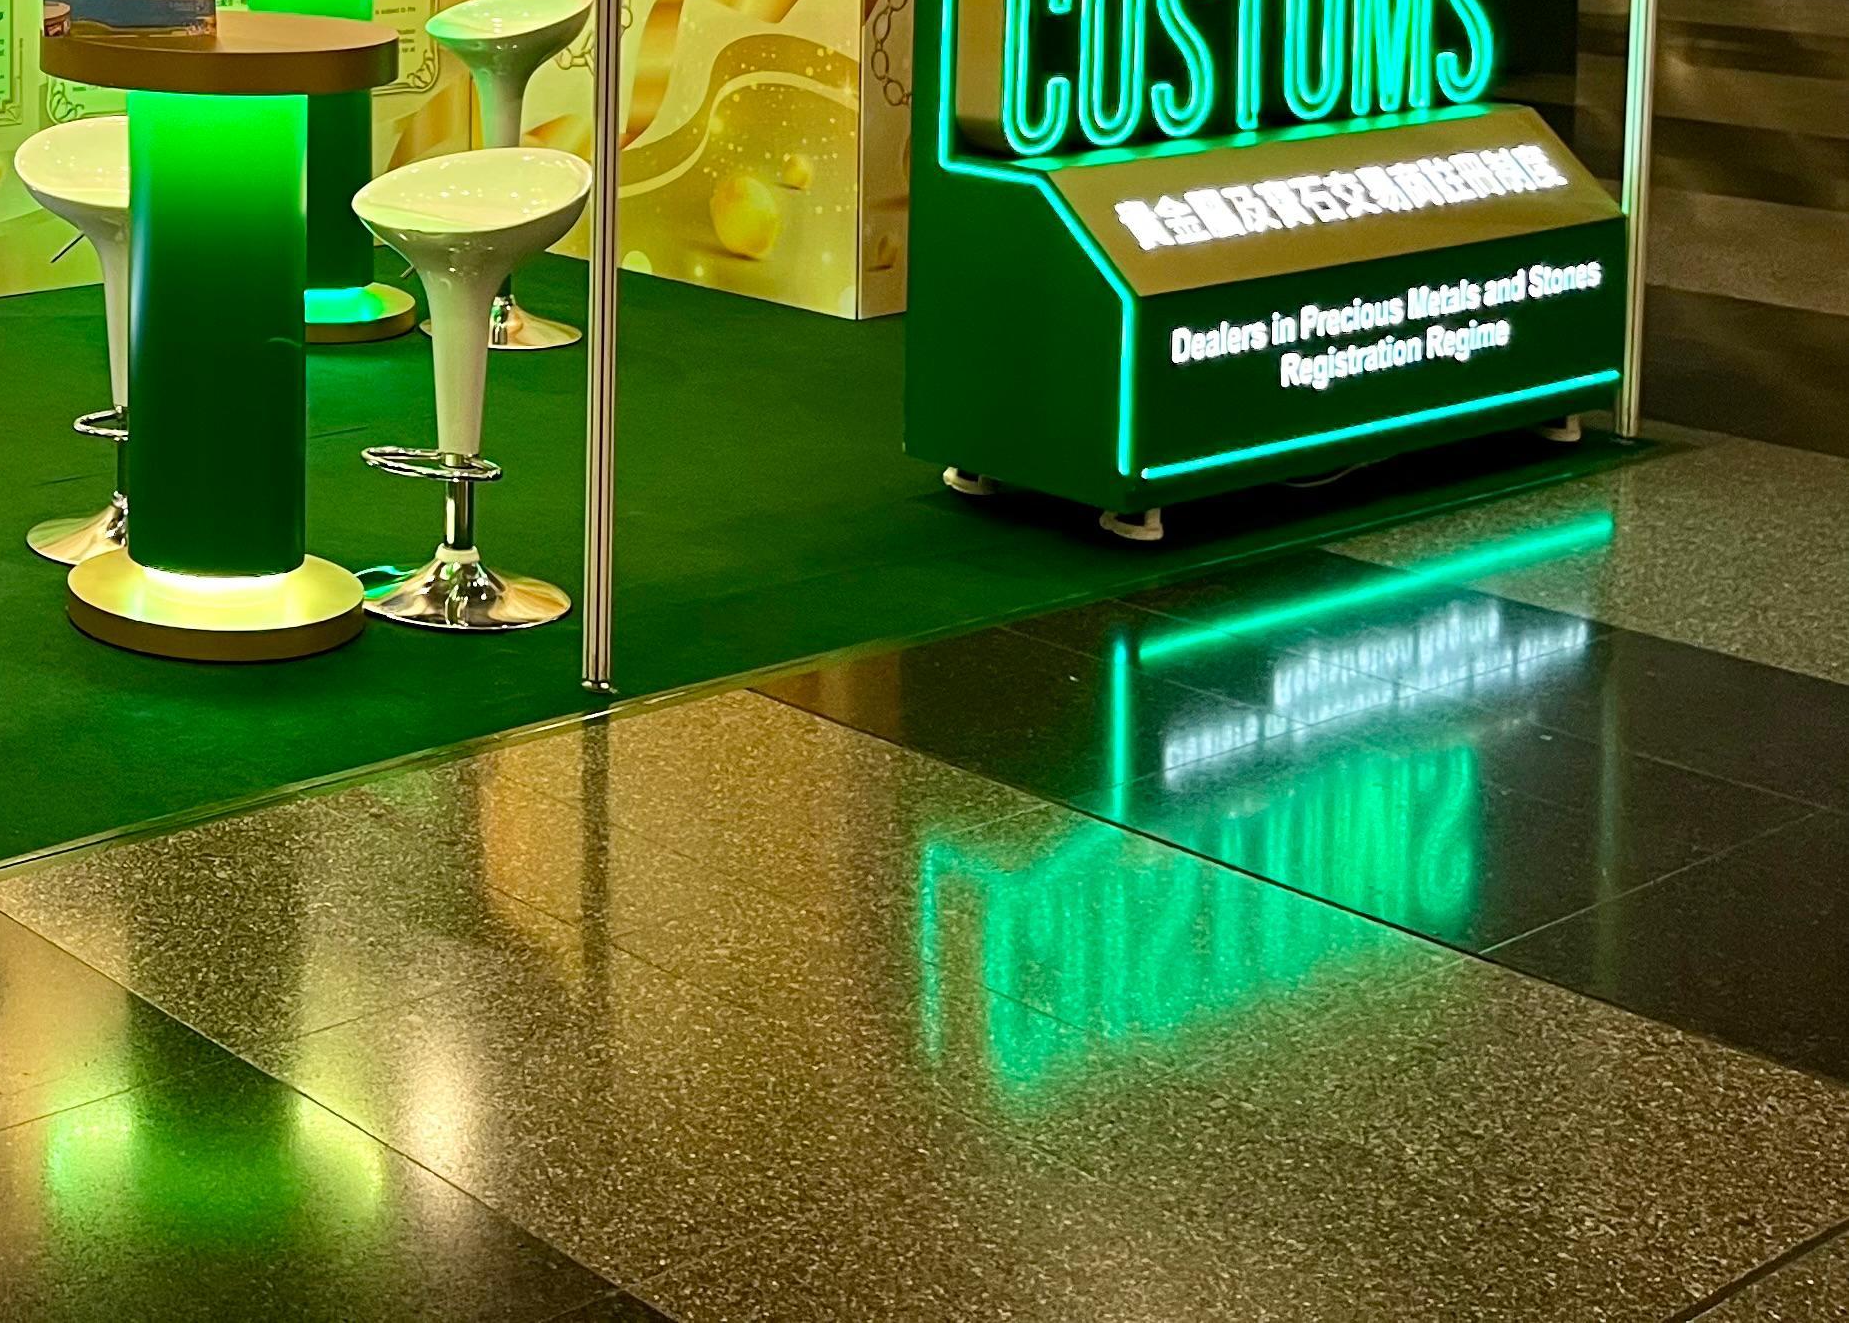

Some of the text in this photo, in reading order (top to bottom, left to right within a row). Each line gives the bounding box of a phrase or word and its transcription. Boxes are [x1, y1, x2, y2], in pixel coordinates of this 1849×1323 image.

[1171, 259, 1602, 364] Dealers in Precious Metals and Stones
[1280, 317, 1510, 390] Registration Regime
